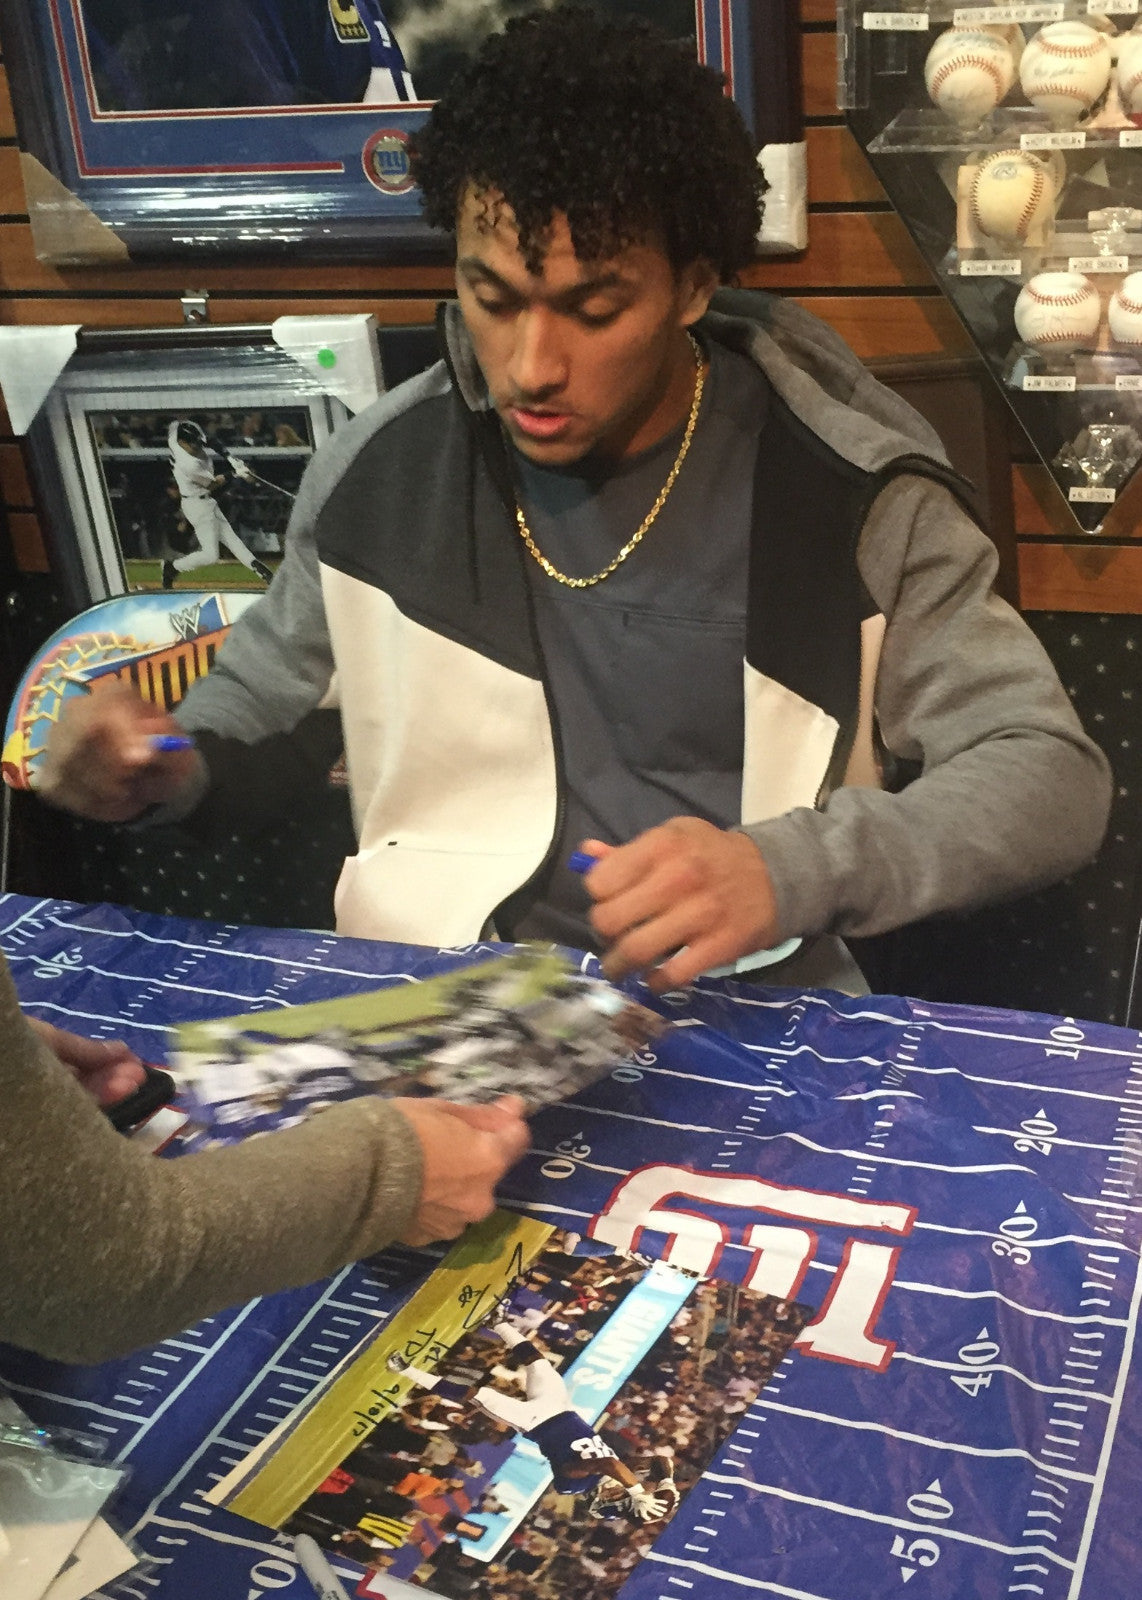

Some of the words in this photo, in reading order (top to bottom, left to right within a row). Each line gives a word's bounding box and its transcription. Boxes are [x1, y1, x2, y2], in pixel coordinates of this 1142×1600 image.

[1044, 1025, 1085, 1061] 10
[540, 1139, 592, 1179] 30
[1013, 1118, 1058, 1157] 20
[991, 1215, 1038, 1266] 30
[949, 1341, 1001, 1398] 40
[889, 1492, 954, 1568] 50
